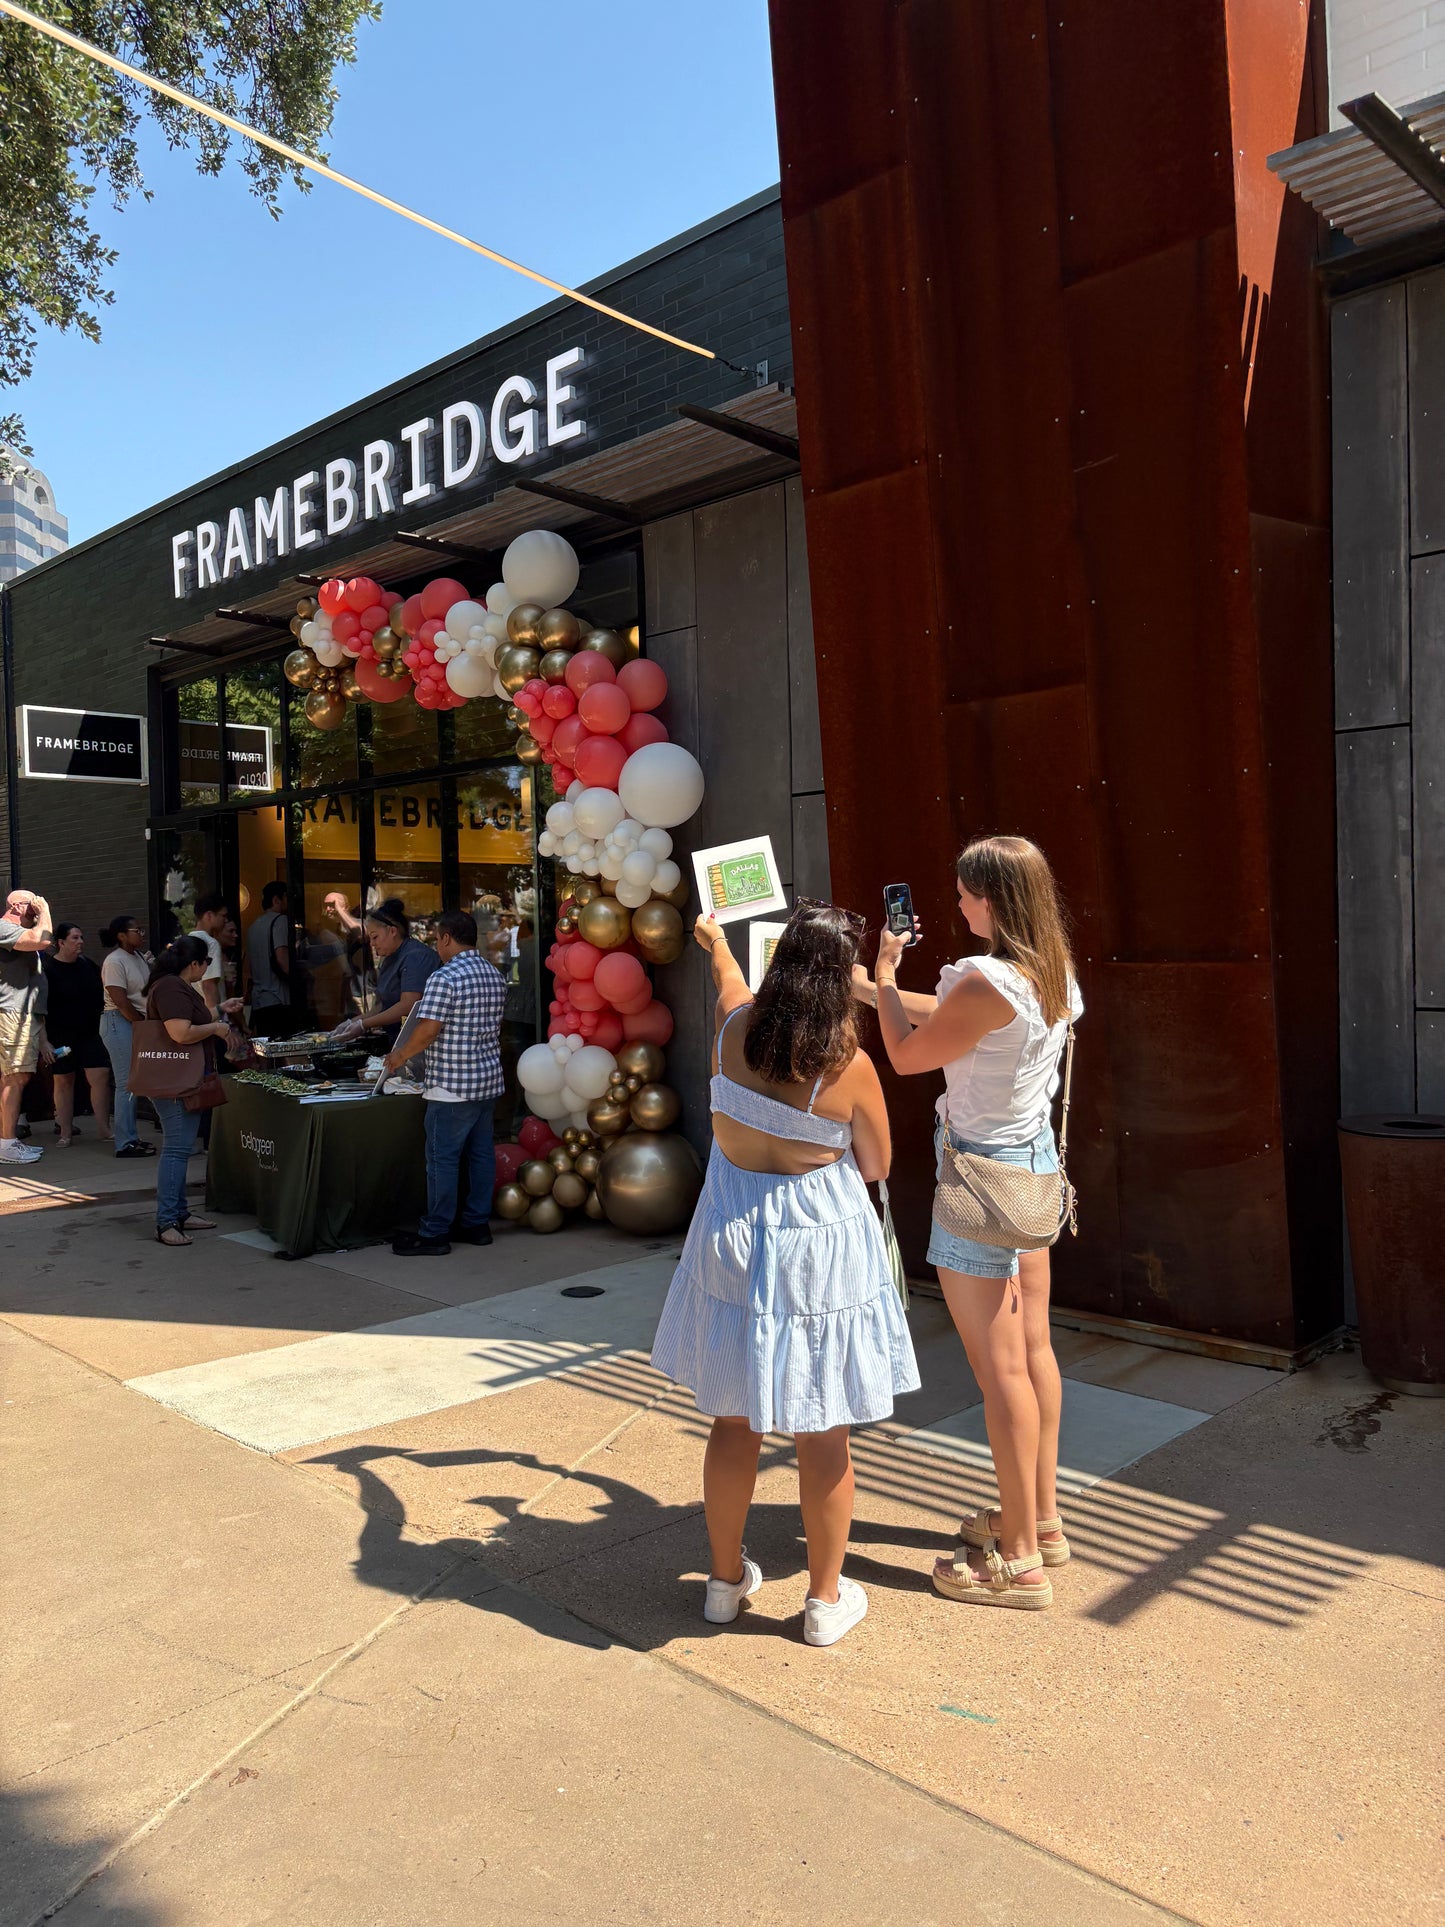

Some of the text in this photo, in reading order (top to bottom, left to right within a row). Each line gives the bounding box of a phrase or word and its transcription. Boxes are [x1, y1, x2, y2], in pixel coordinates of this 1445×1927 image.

[172, 346, 587, 599] FRAMEBRIDGE
[36, 736, 134, 754] FRAMEBRIDGE
[730, 863, 759, 876] DALLAS
